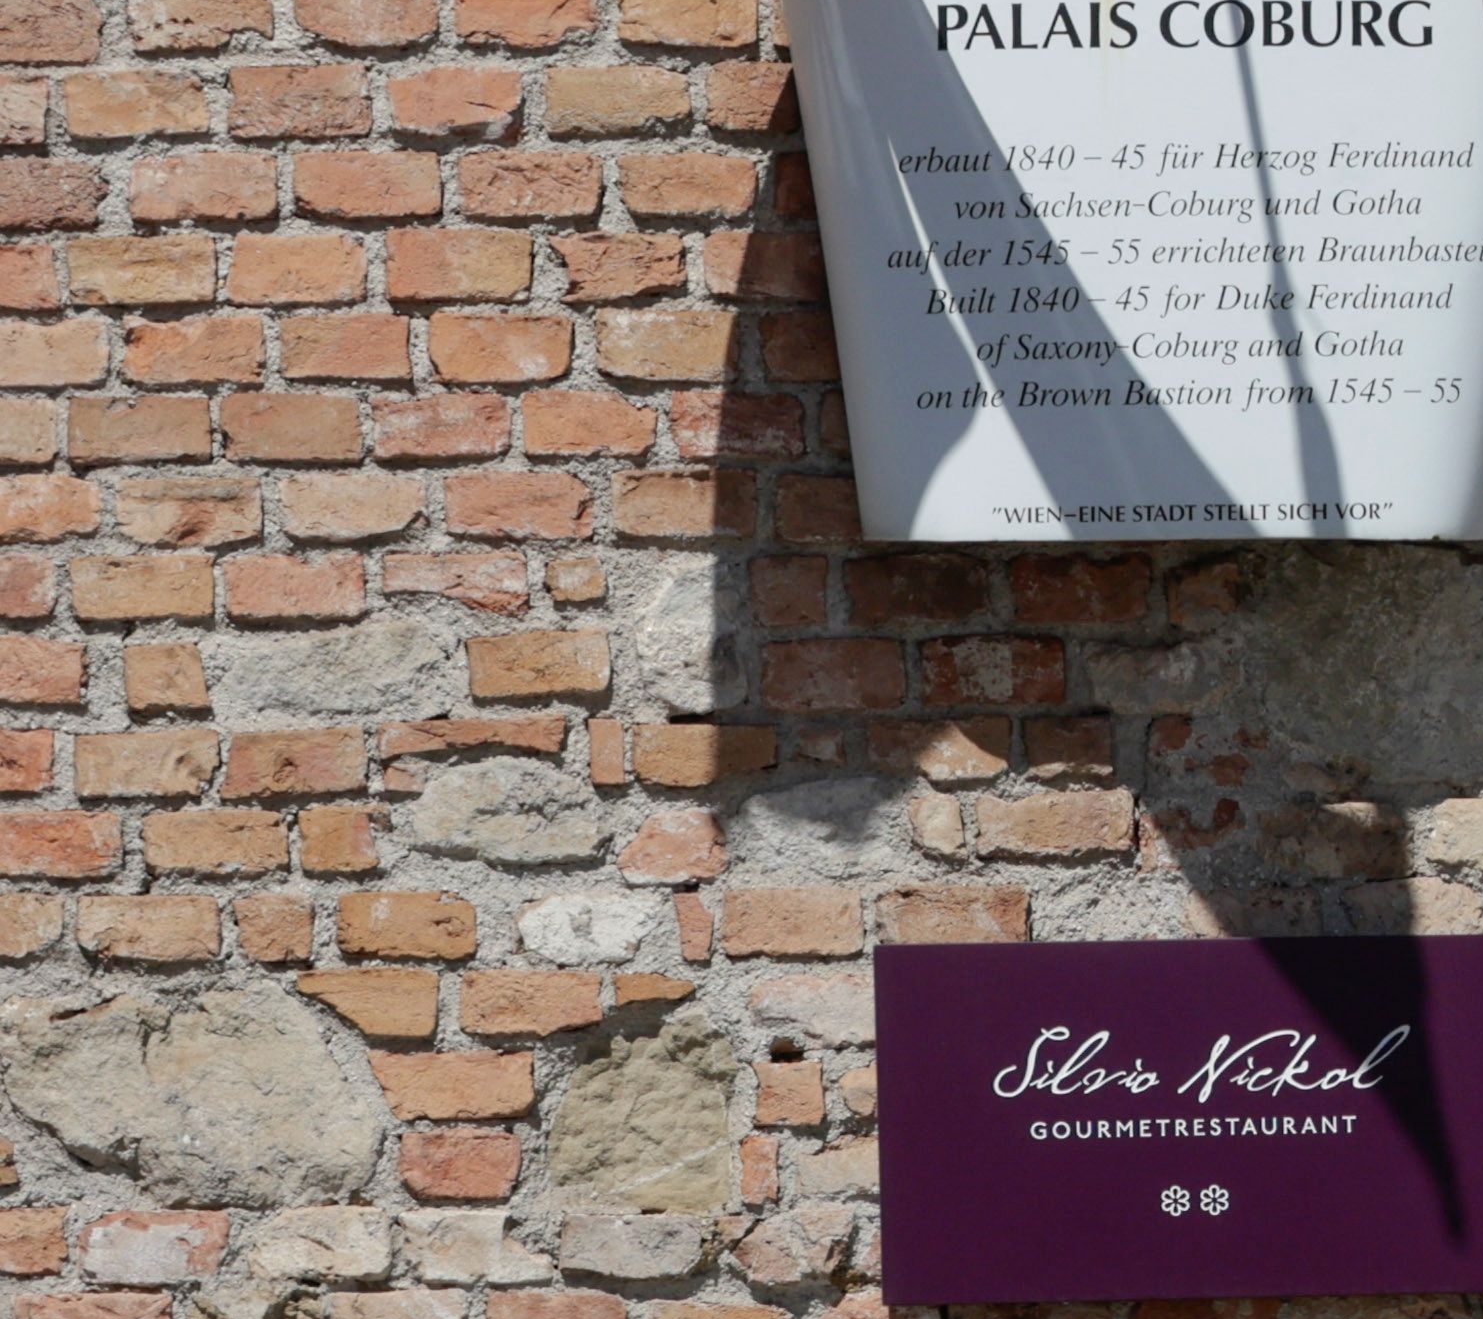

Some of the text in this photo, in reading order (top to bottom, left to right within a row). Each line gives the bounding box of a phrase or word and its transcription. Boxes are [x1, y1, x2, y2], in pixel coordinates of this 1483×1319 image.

[937, 0, 1139, 52] PALAIS
[899, 146, 992, 174] erbaut
[1003, 145, 1075, 172] 1840
[1111, 143, 1146, 171] 45
[1156, 143, 1204, 177] für
[1213, 143, 1318, 177] Herzog
[1328, 141, 1475, 169] Ferdinand
[953, 188, 1422, 224] von Sachsen-Coburg und Gotha
[887, 240, 938, 276] auf
[943, 240, 992, 266] der
[1002, 238, 1072, 266] 1545
[1107, 238, 1142, 265] 55
[1152, 237, 1305, 264] errichteten
[926, 287, 997, 315] Built
[1007, 286, 1080, 314] 1840
[1115, 285, 1150, 312] 45
[1160, 284, 1205, 319] for
[1216, 283, 1295, 311] Duke
[1306, 282, 1454, 311] Ferdinand
[976, 330, 1404, 369] of Saxony-Coburg and Gotha
[916, 389, 953, 410] on
[961, 382, 1005, 409] the
[1017, 381, 1111, 408] Brown
[1123, 379, 1232, 406] Bastion
[1242, 378, 1313, 412] from
[1325, 377, 1394, 404] 1545
[1430, 377, 1462, 404] 55
[1132, 503, 1197, 523] STADT
[1203, 503, 1270, 522] STELLT
[1277, 502, 1328, 521] SICH
[993, 1024, 1411, 1104] Silvio Nickol
[1029, 1114, 1358, 1140] GOURMETRESTAURANT
